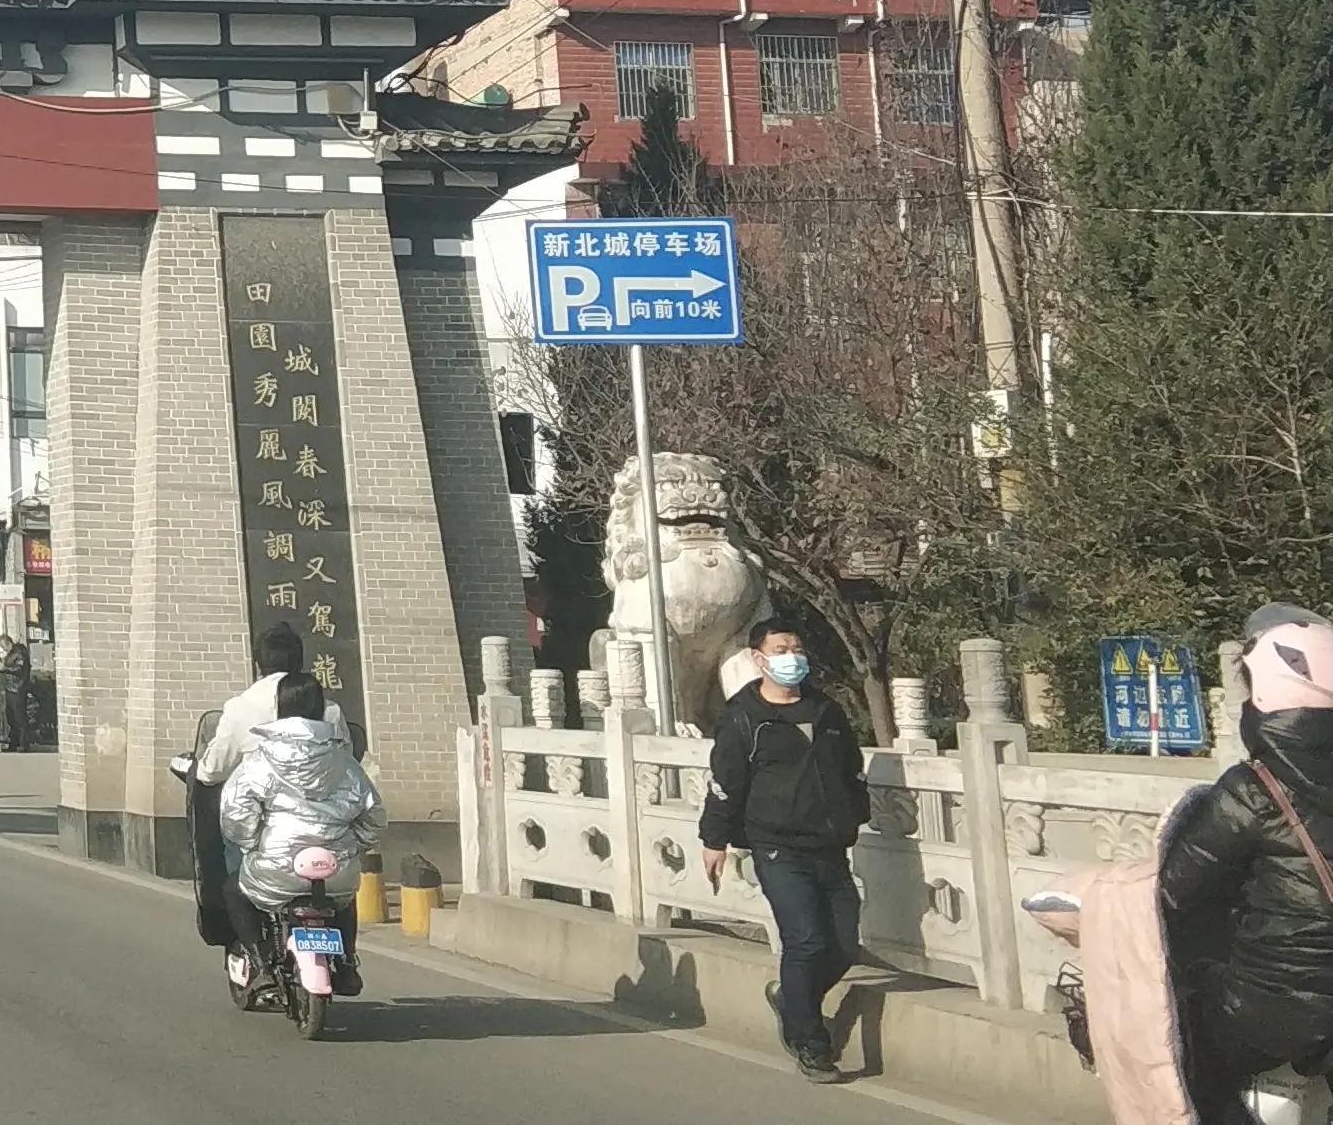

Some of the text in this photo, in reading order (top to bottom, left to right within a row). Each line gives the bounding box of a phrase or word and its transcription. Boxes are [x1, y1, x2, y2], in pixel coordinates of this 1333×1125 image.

[543, 231, 722, 257] 新北城停车场
[548, 265, 601, 332] P
[631, 298, 722, 320] 向前10米
